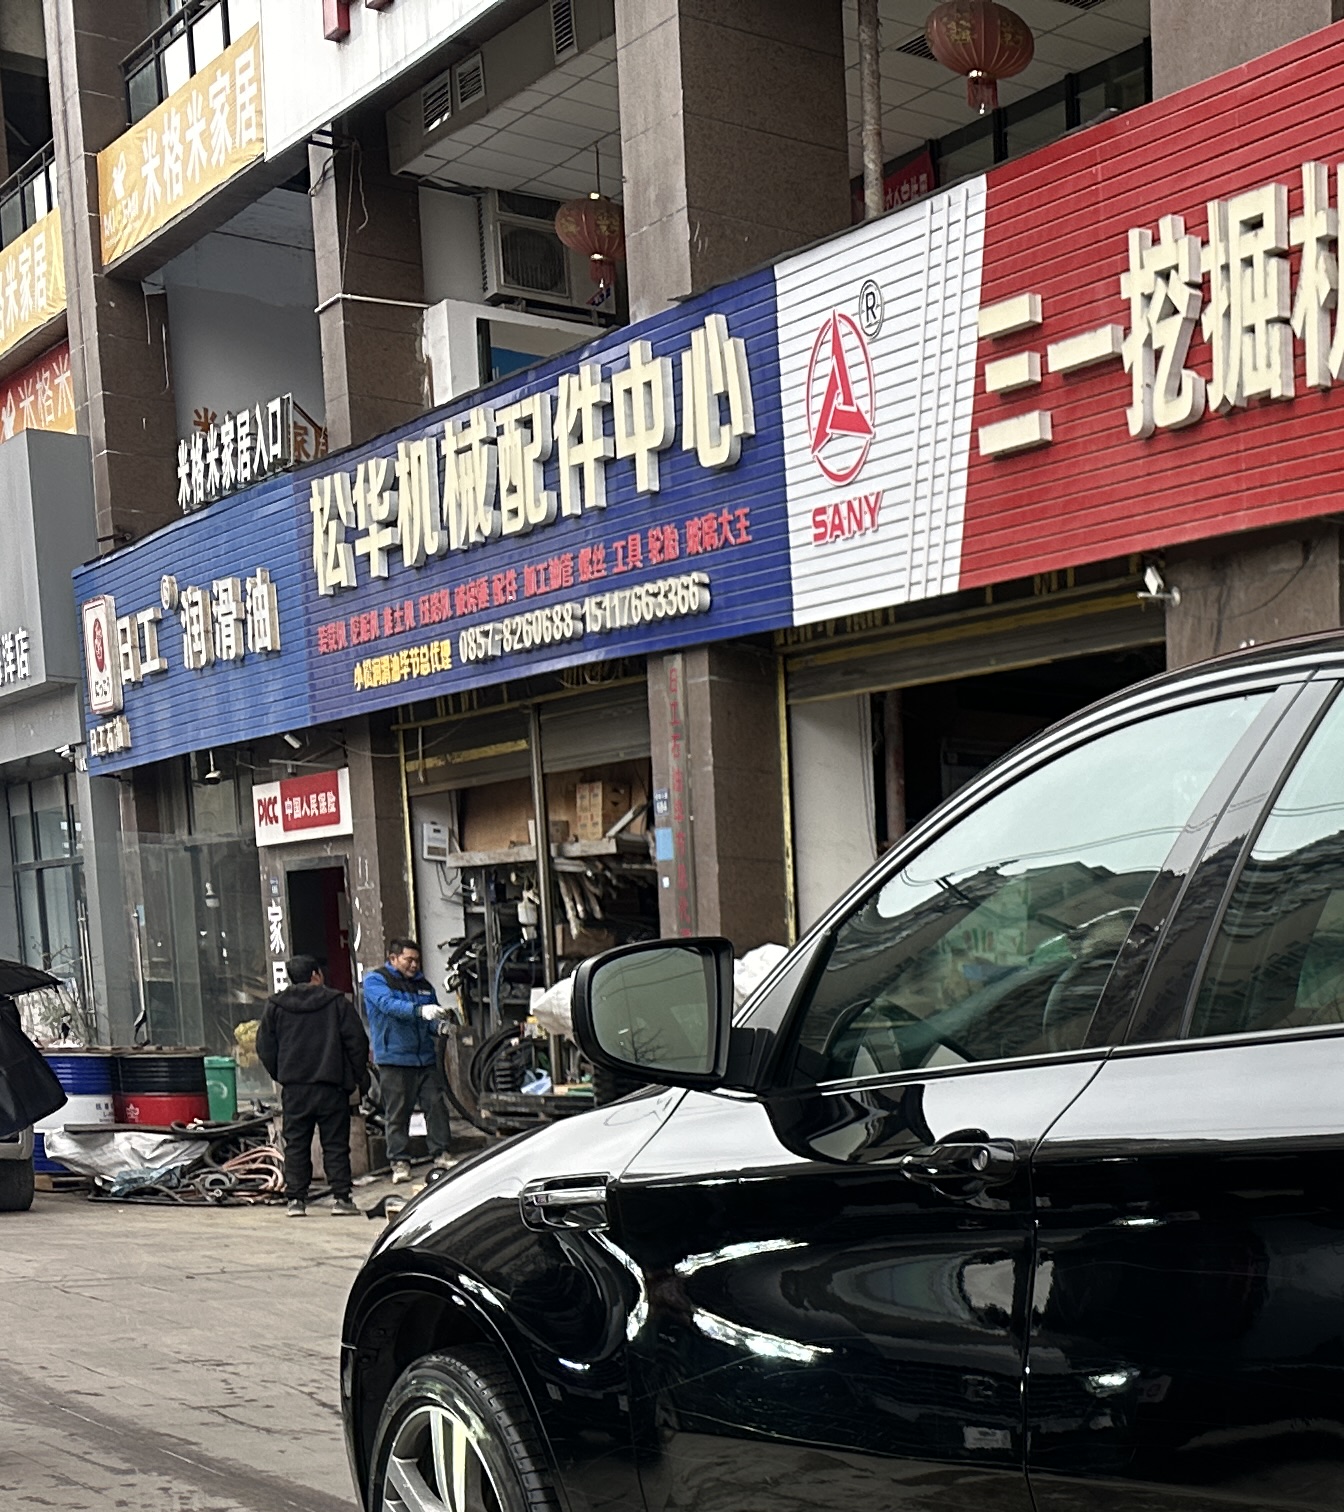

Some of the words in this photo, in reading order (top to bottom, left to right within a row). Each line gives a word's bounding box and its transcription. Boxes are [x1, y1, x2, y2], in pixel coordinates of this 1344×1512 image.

[141, 46, 258, 216] 米格米家居
[0, 231, 47, 341] 米家居
[310, 313, 755, 596] 松华机械配件中心
[811, 489, 884, 546] SANY
[0, 627, 28, 685] 洋店
[117, 607, 167, 685] 日工
[181, 567, 280, 669] 润滑油
[257, 796, 279, 828] PICC
[284, 790, 336, 821] 中国人民保险
